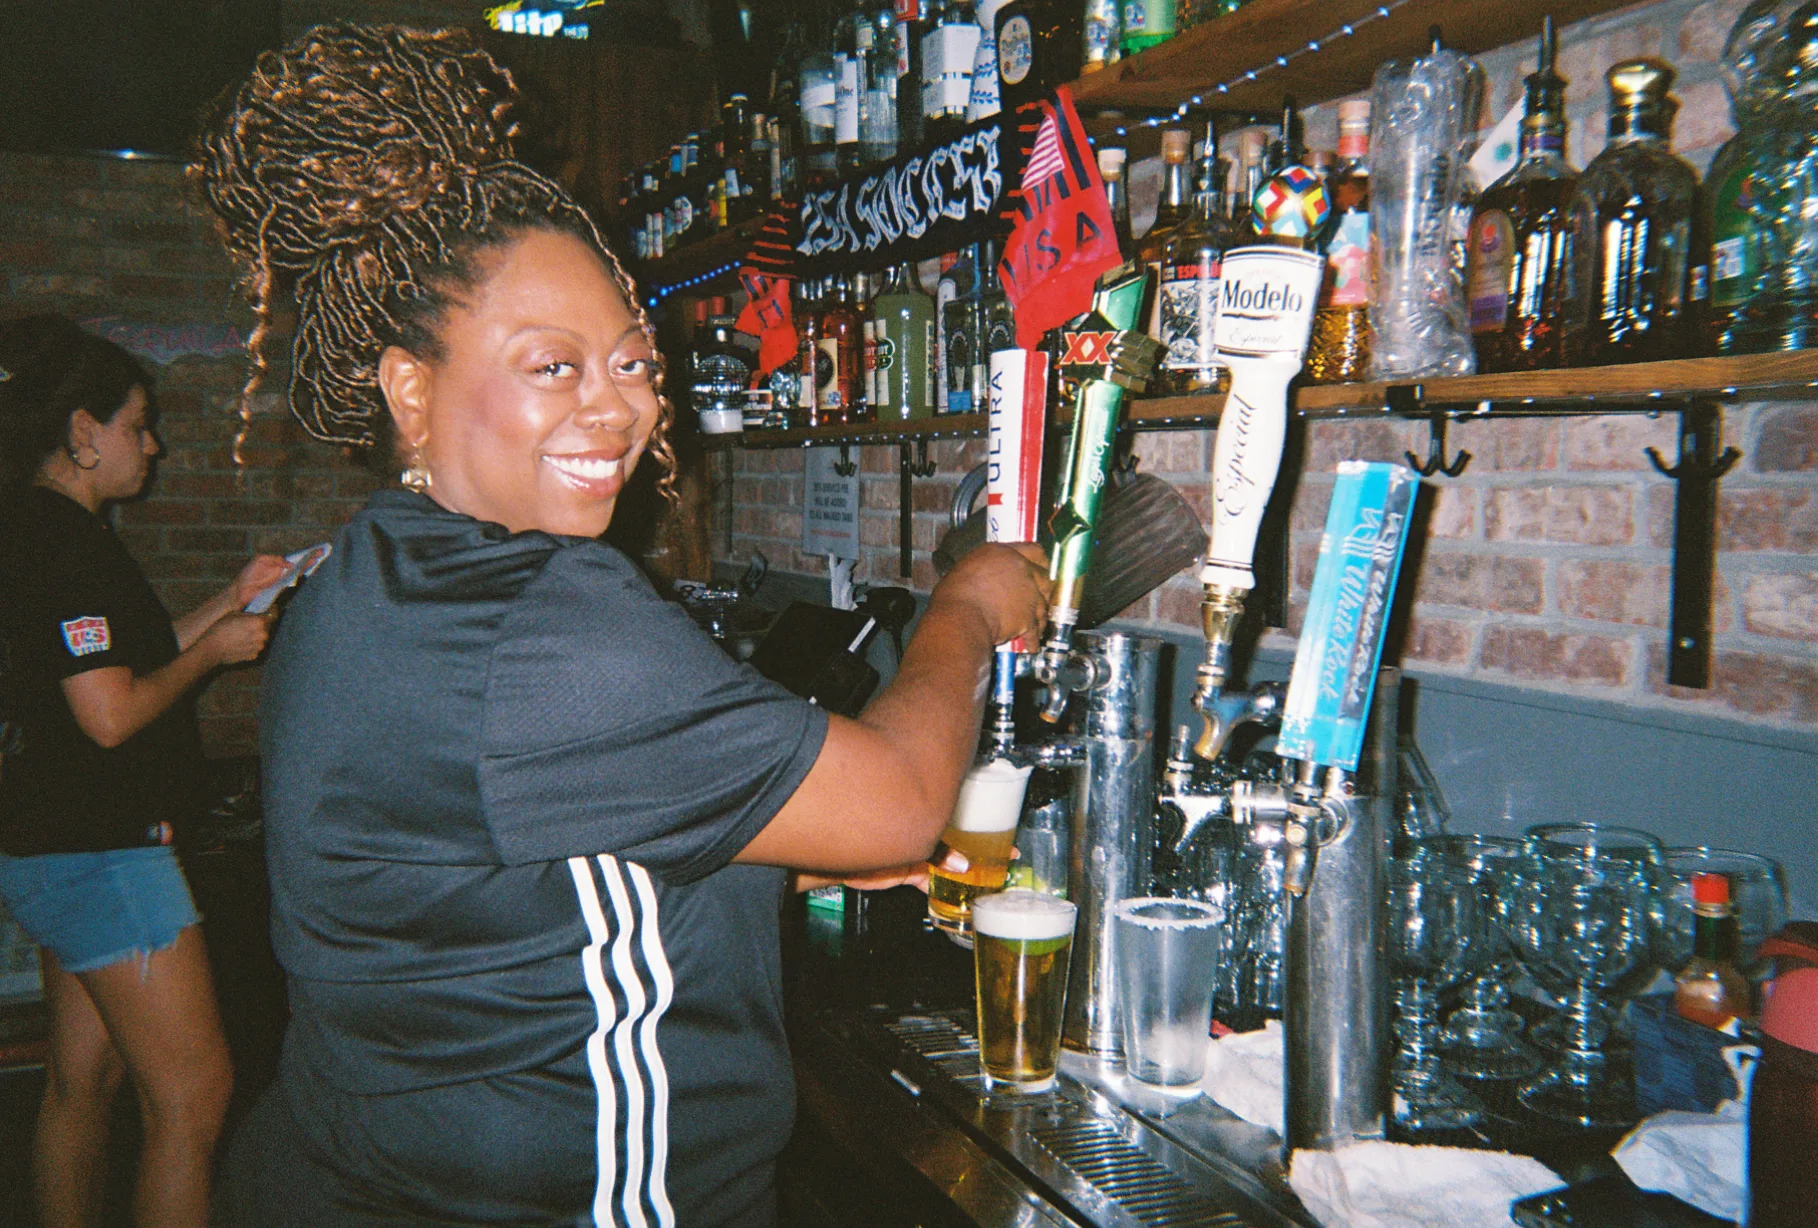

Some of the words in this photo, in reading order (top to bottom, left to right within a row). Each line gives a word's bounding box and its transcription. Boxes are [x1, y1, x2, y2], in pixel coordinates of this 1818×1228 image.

[856, 124, 1002, 251] SOCCER
[1003, 210, 1103, 290] USA
[1221, 279, 1303, 312] Modelo
[1060, 330, 1118, 365] XX
[988, 370, 1004, 483] ULTRA
[1215, 393, 1257, 526] Especial
[1332, 563, 1369, 640] White
[1320, 637, 1352, 702] Rock
